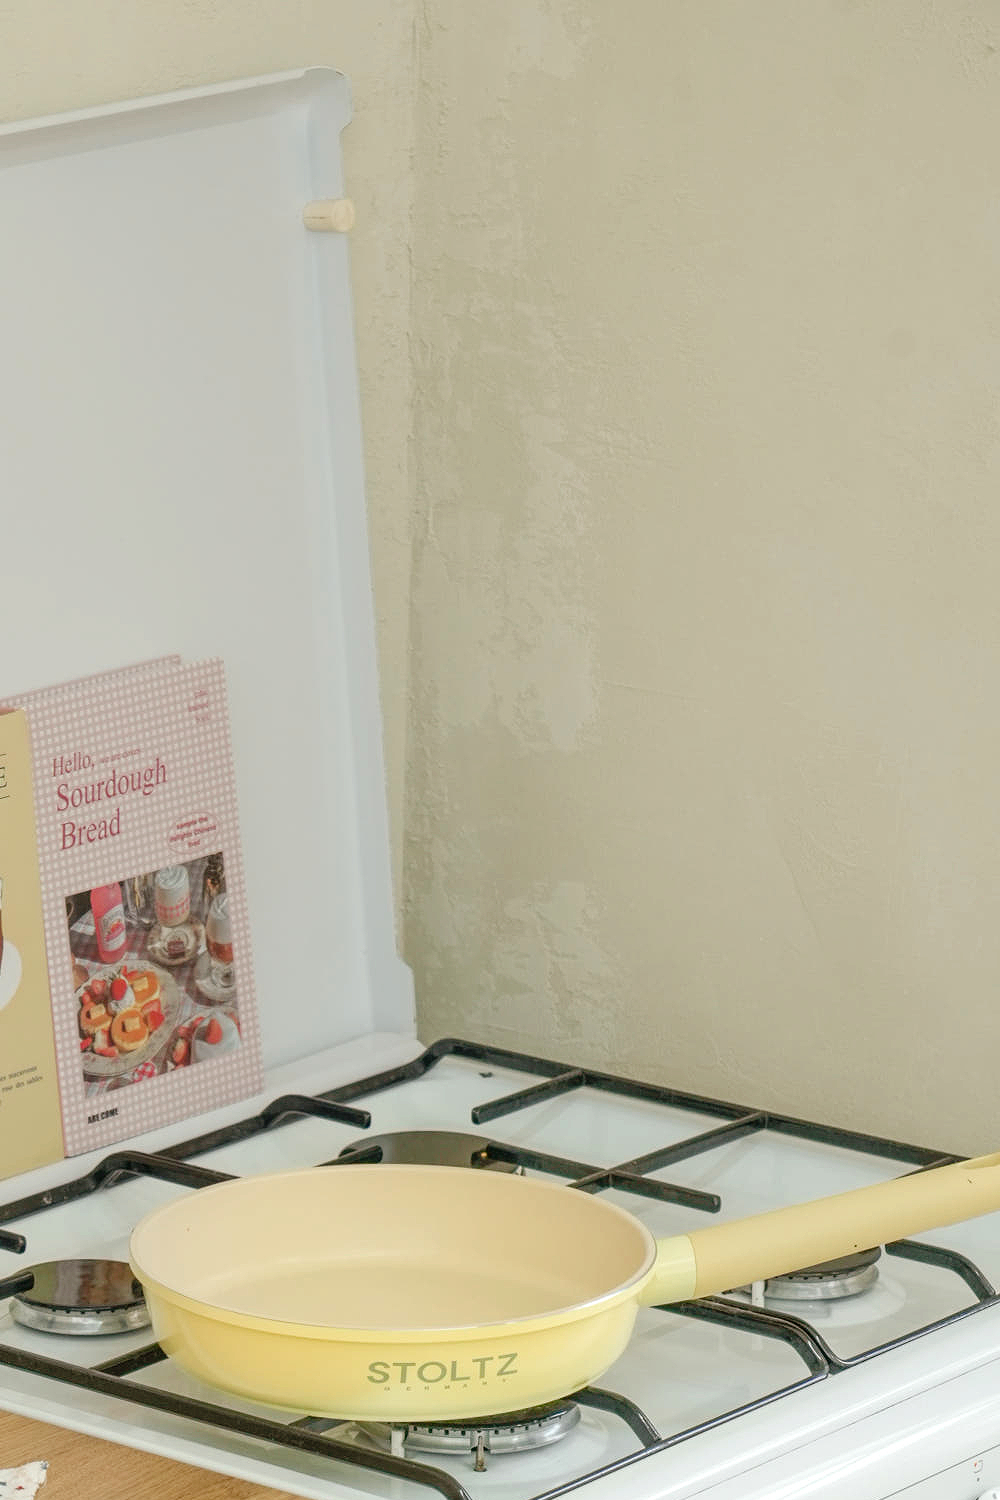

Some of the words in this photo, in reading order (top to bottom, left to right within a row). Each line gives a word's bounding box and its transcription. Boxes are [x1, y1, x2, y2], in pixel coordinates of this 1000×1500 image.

[52, 752, 94, 777] Hello,
[57, 757, 167, 811] Sourdough
[61, 807, 121, 850] Bread
[367, 1353, 518, 1384] STOLTZ
